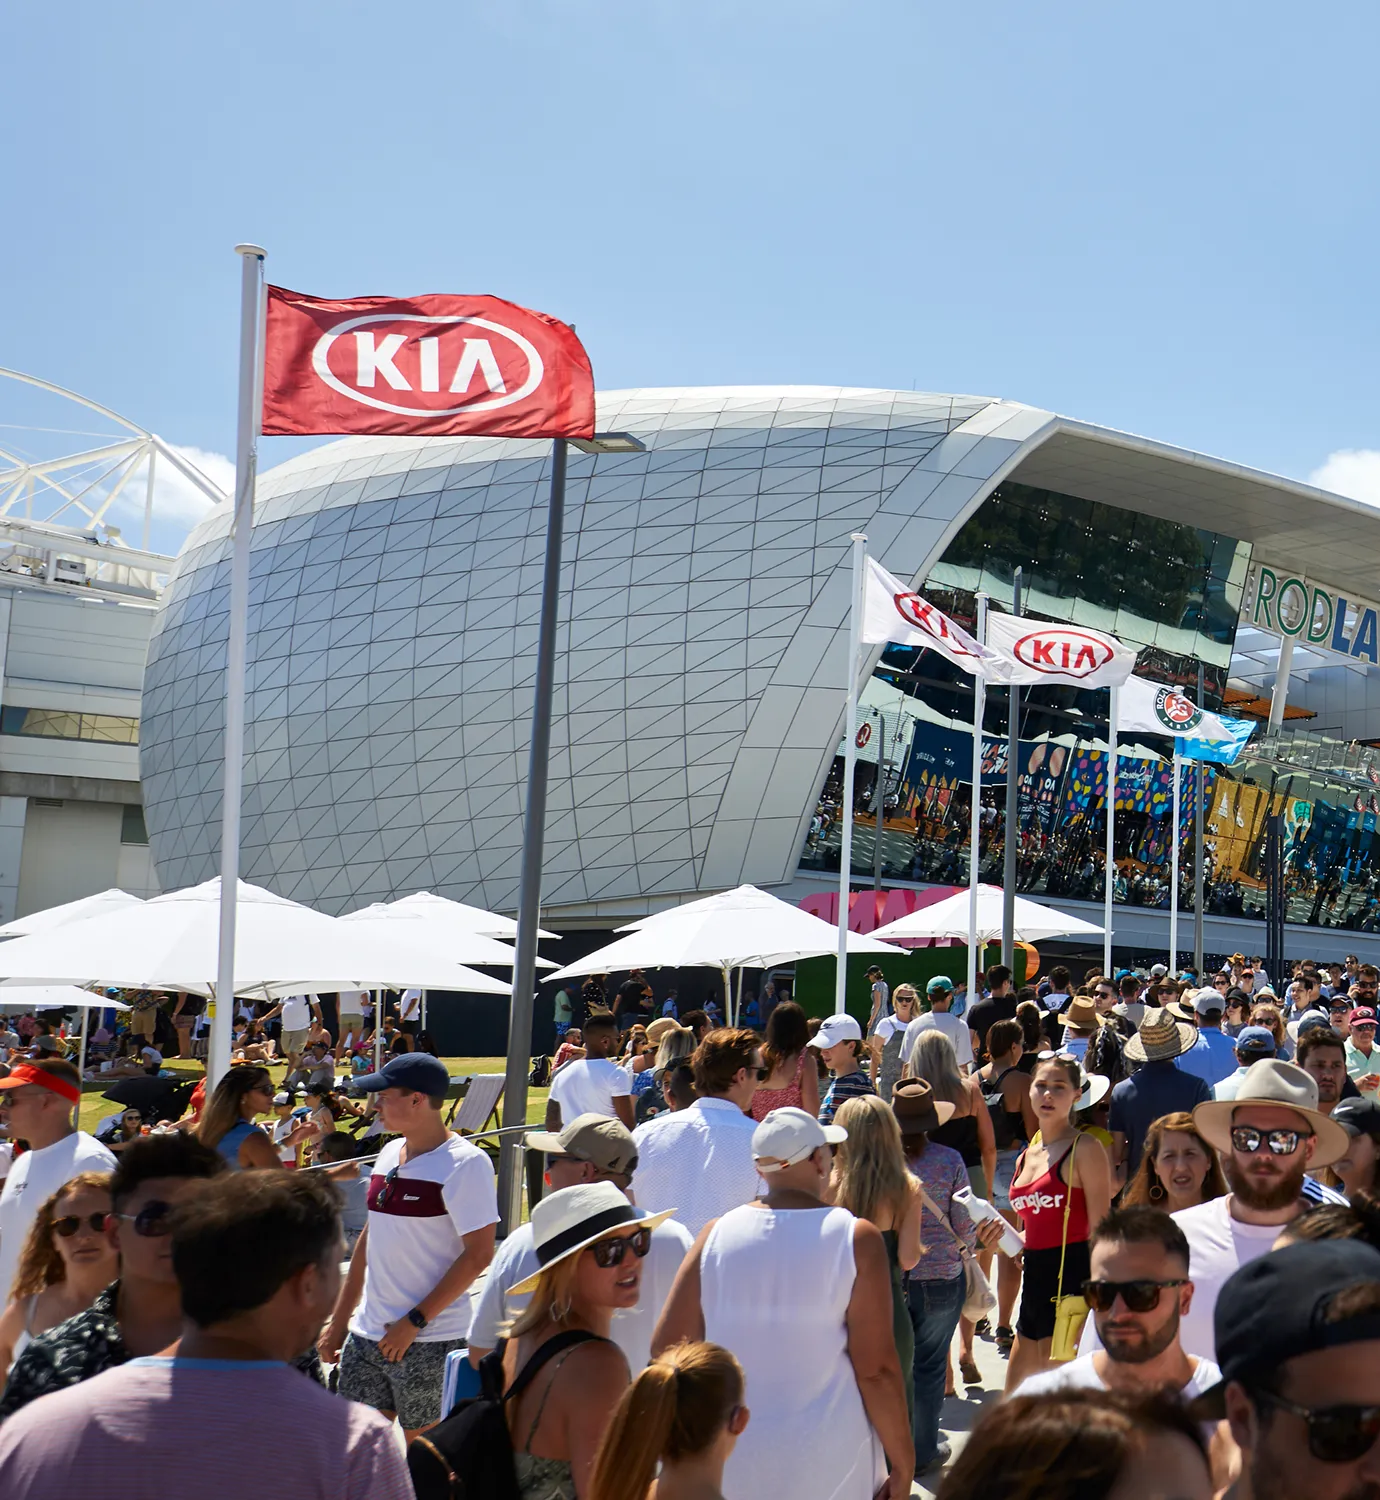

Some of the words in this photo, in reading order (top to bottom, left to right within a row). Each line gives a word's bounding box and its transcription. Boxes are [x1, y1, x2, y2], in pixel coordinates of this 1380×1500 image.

[353, 331, 508, 395] KIA
[1253, 566, 1333, 643] ROD
[1032, 639, 1097, 669] KIA
[1162, 716, 1195, 729] PARIS
[1010, 1191, 1064, 1215] rangler
